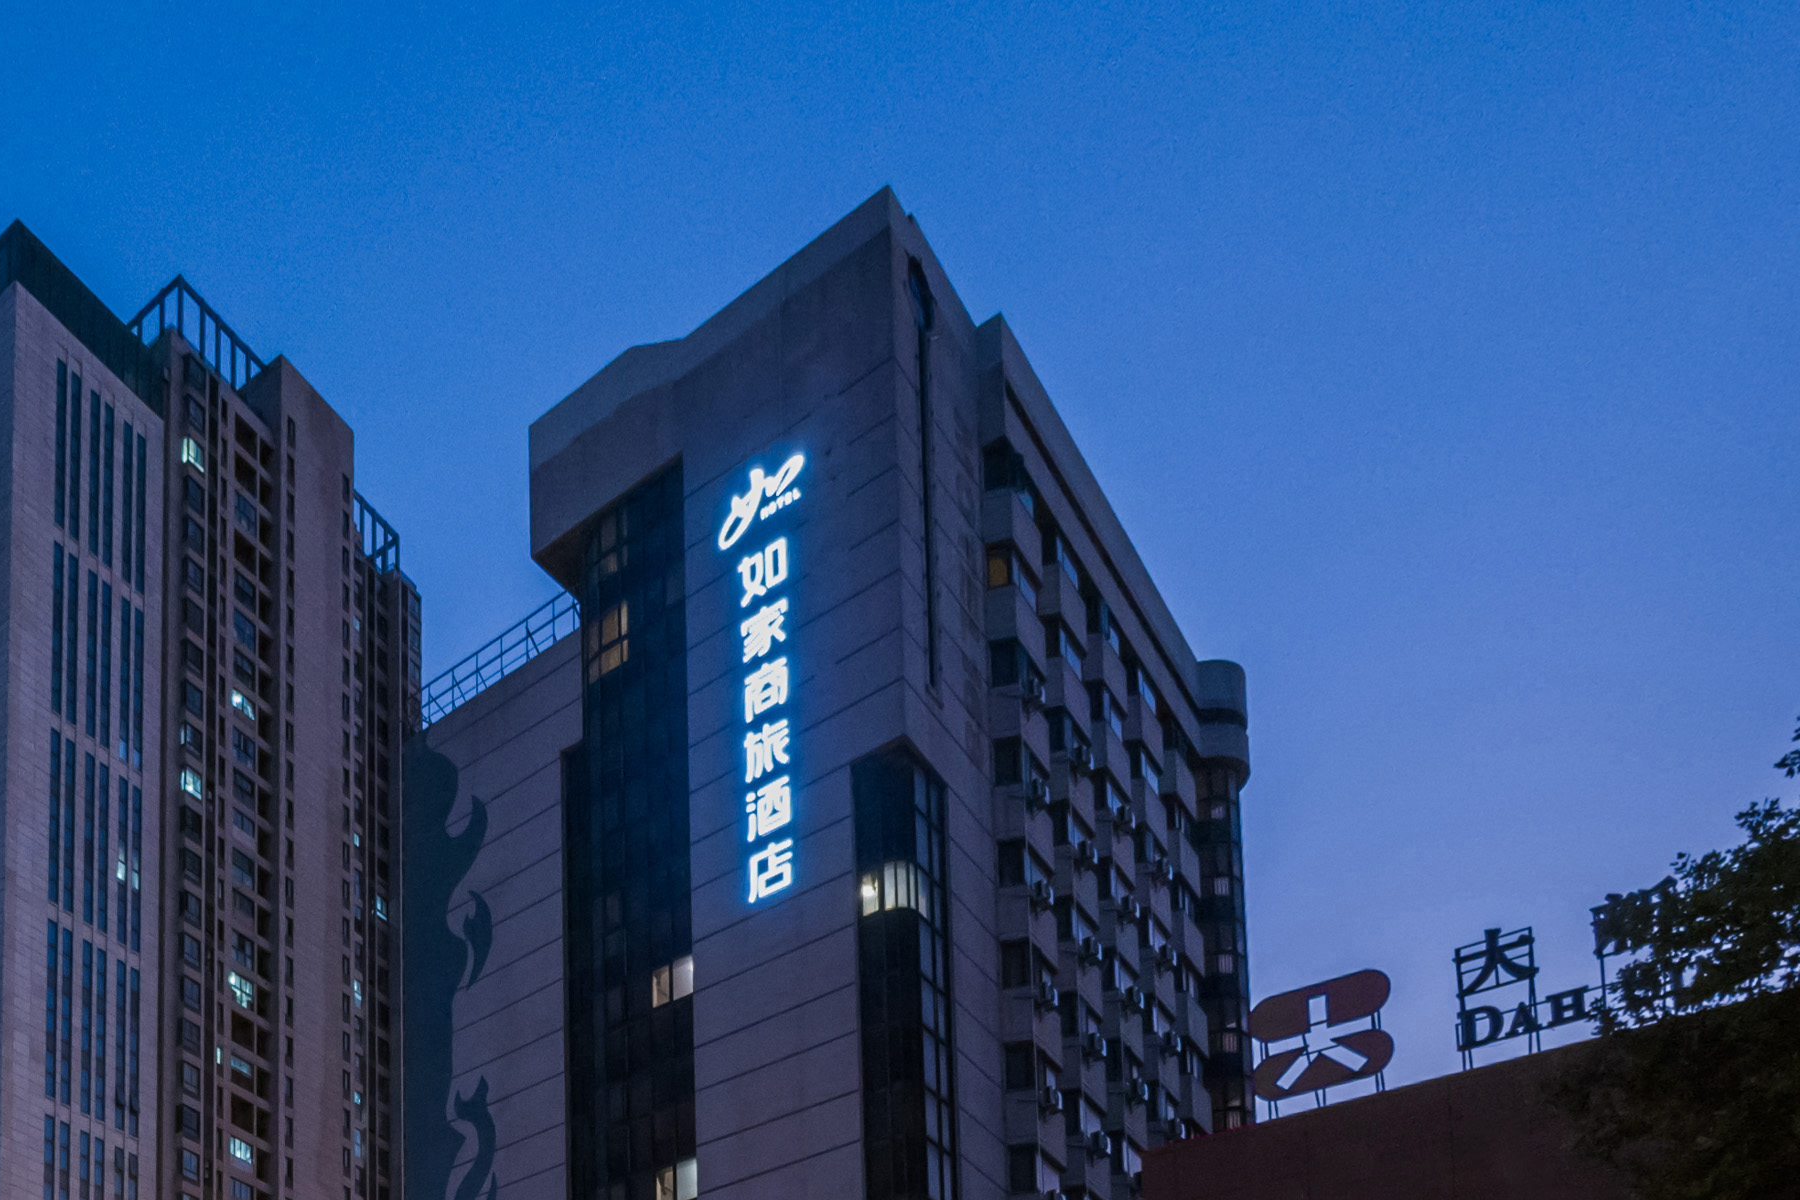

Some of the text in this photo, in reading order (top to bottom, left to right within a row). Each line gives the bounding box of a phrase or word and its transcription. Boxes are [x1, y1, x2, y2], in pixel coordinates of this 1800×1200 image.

[736, 536, 793, 904] 如家商旅酒店
